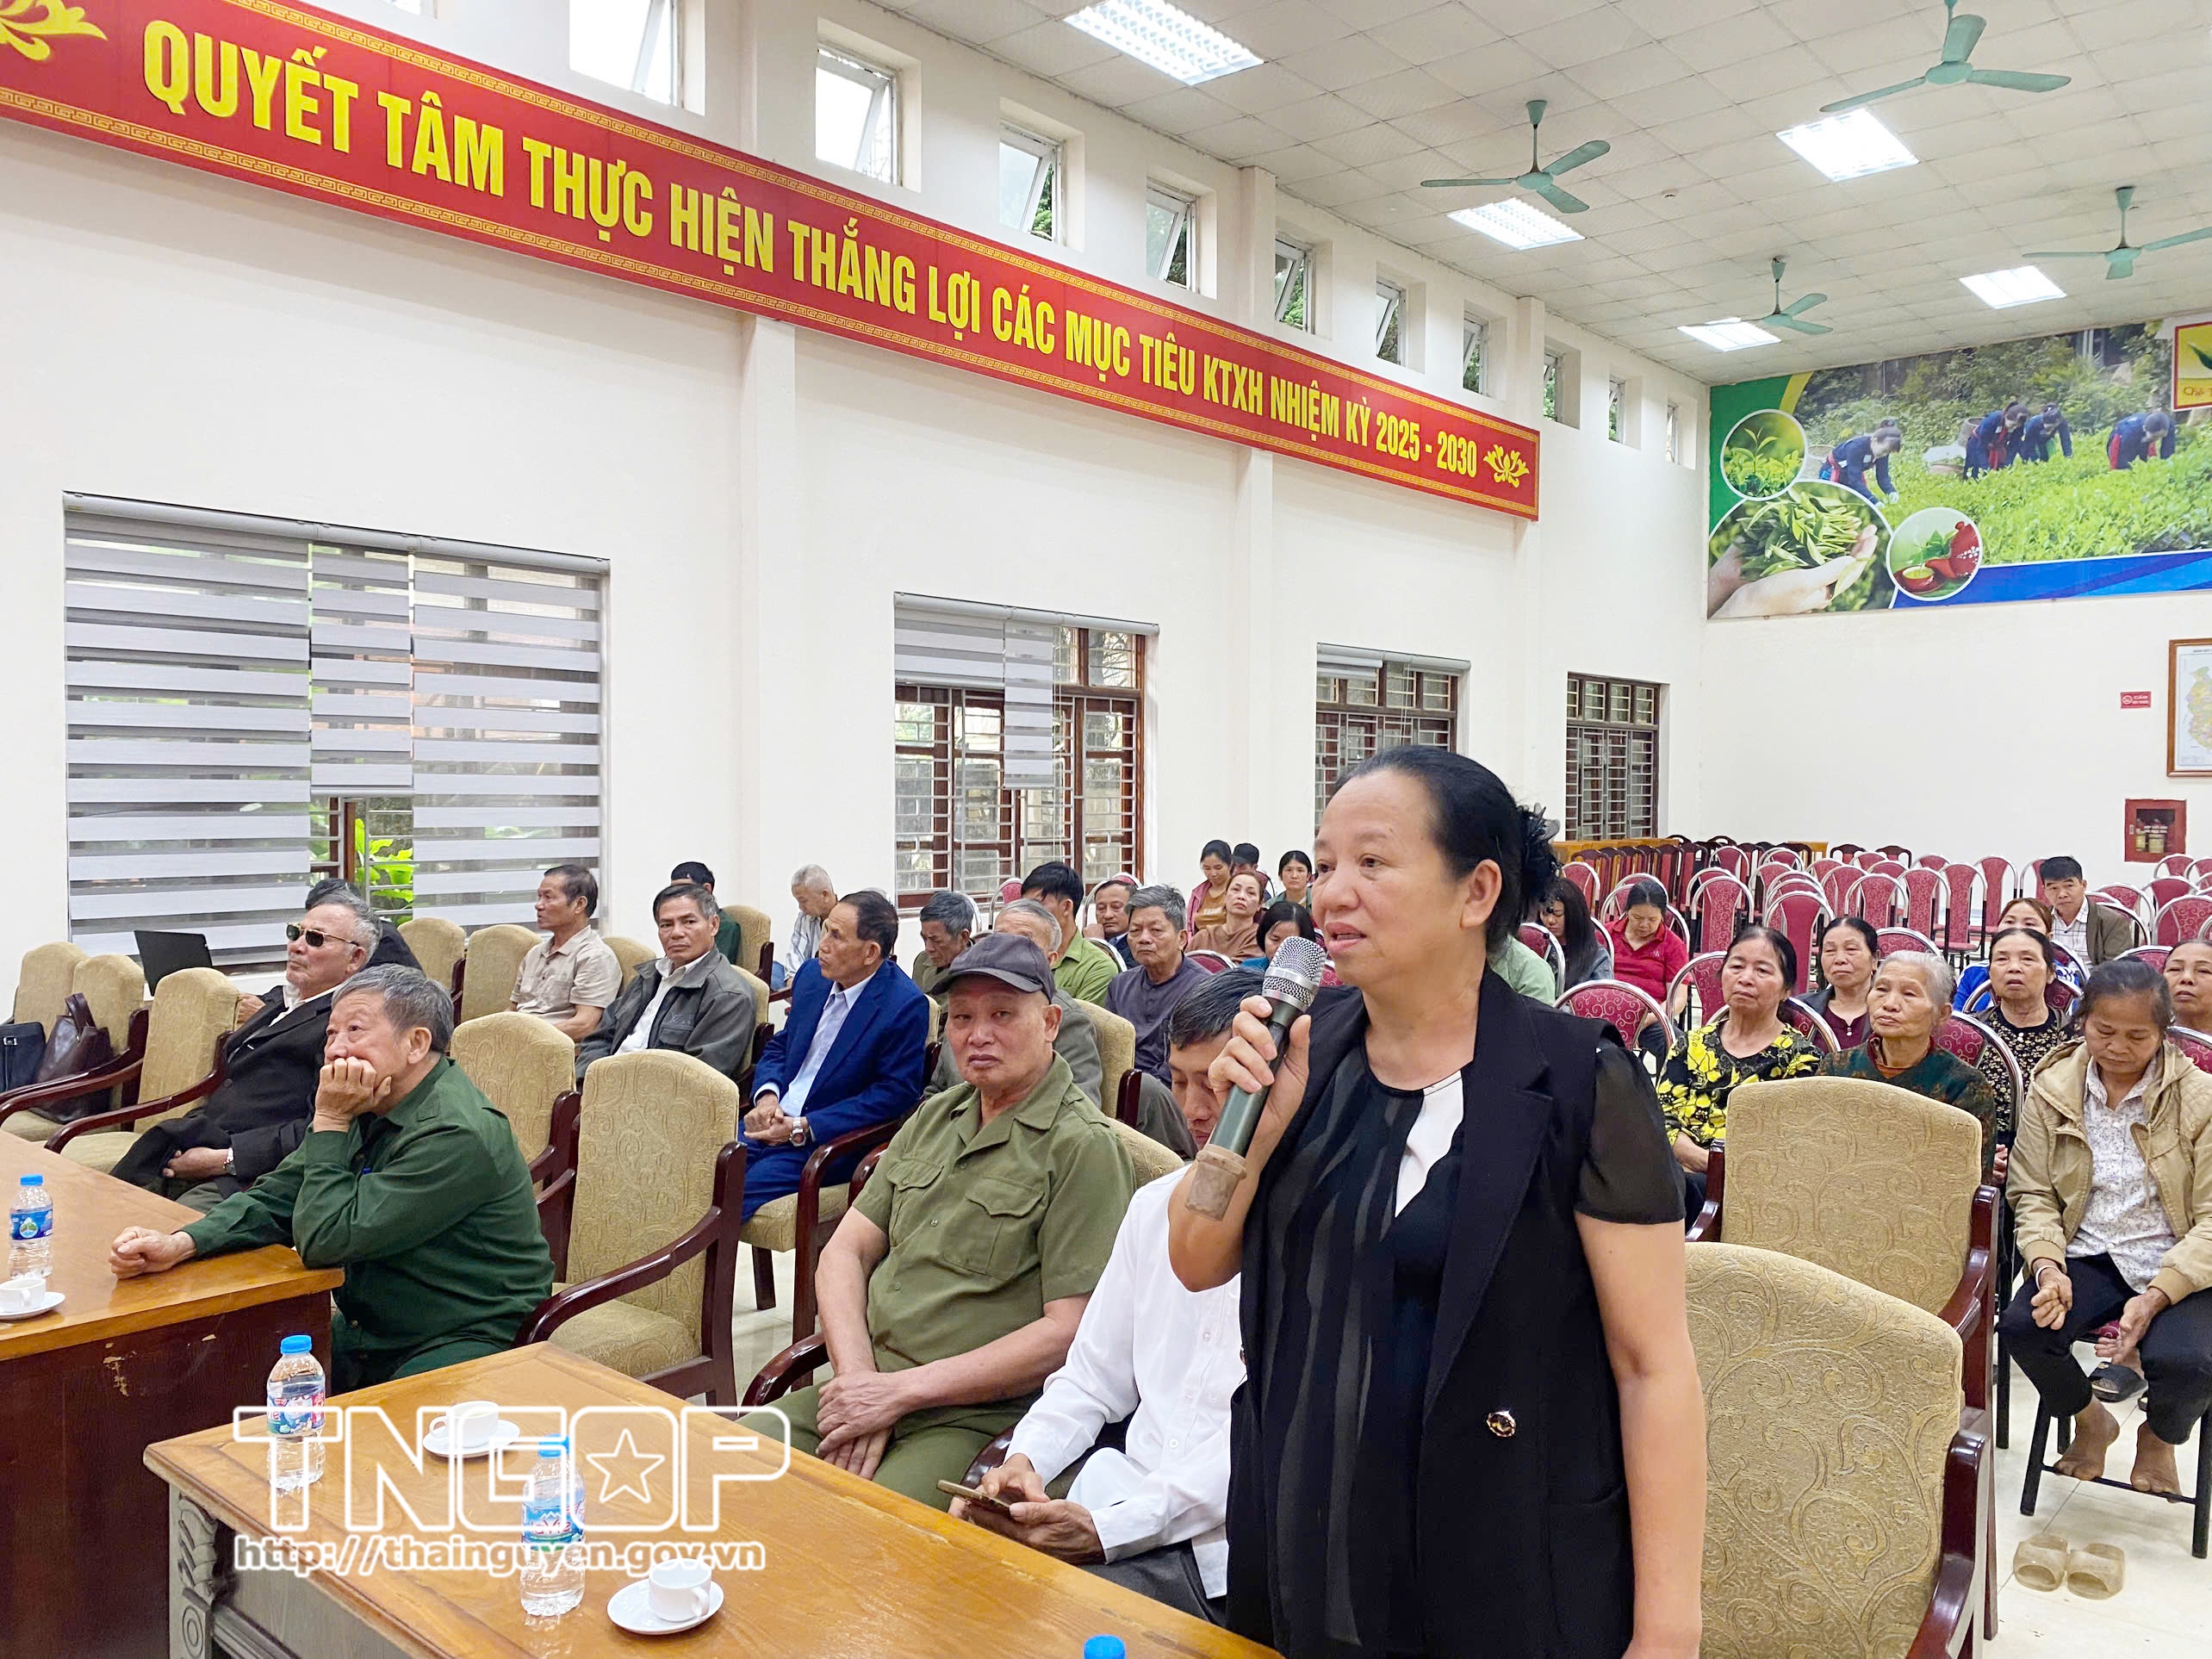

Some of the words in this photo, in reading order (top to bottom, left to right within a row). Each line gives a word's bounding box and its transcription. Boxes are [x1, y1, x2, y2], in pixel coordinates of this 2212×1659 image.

[143, 19, 359, 153] QUYẾT
[377, 91, 504, 198] TÂM
[522, 137, 654, 243] THỰC
[670, 183, 774, 276] HIỆN
[786, 216, 916, 314] THẮNG
[928, 268, 981, 343] LỢI
[991, 285, 1056, 356] CÁC
[1066, 308, 1130, 382] MỤC
[1139, 334, 1196, 396] TIÊU
[1202, 355, 1264, 415] KTXH
[1271, 377, 1339, 443] NHIỆM
[1345, 395, 1372, 446] KỲ
[1376, 412, 1421, 463] 2025
[1437, 431, 1478, 478] 2030
